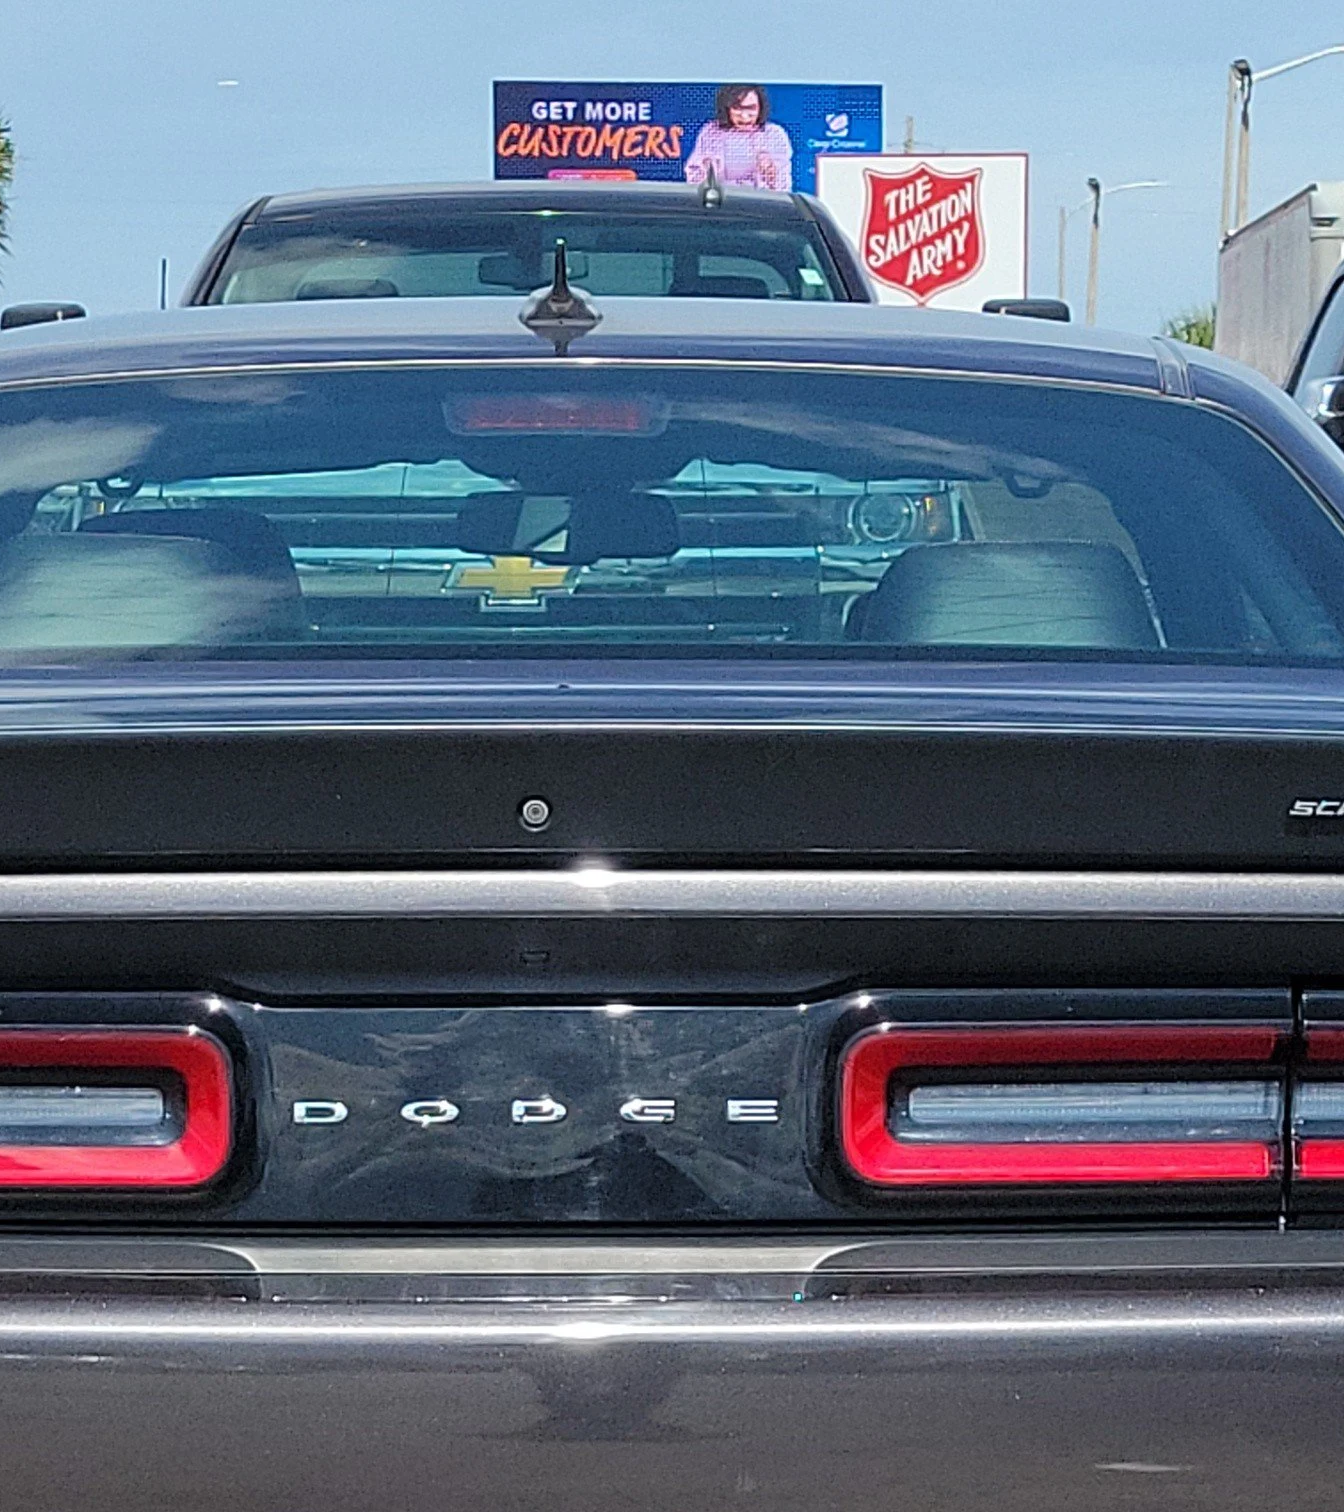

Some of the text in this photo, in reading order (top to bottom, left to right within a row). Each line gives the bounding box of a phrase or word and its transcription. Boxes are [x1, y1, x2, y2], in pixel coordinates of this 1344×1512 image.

[531, 100, 652, 121] GET MORE
[497, 122, 684, 161] CUSTOMERS
[884, 175, 933, 222] THE
[868, 181, 972, 269] SALVATION
[905, 220, 970, 286] ARMY
[293, 1098, 779, 1126] DODGE
